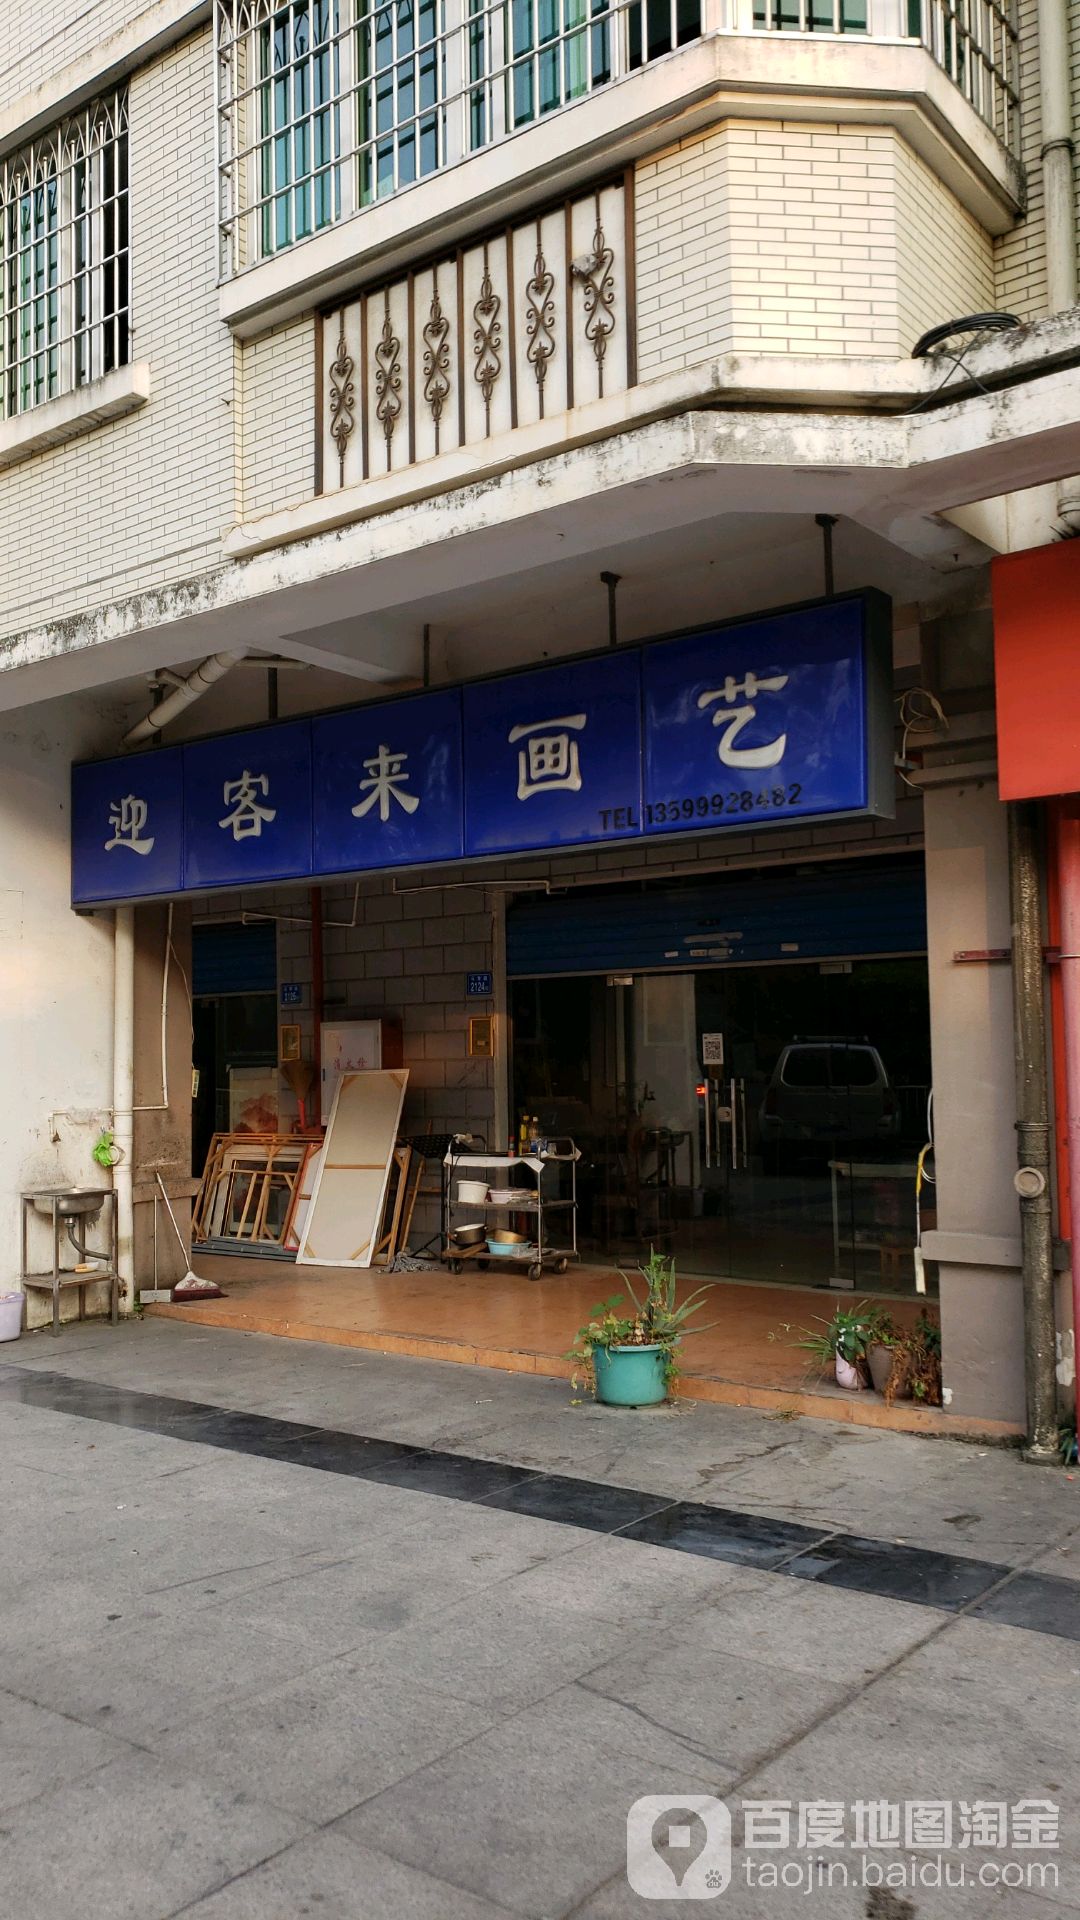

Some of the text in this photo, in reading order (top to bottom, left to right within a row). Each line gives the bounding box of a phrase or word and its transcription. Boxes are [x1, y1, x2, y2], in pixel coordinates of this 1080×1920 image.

[104, 674, 789, 854] 迎客来画艺
[644, 783, 803, 824] 13599928482
